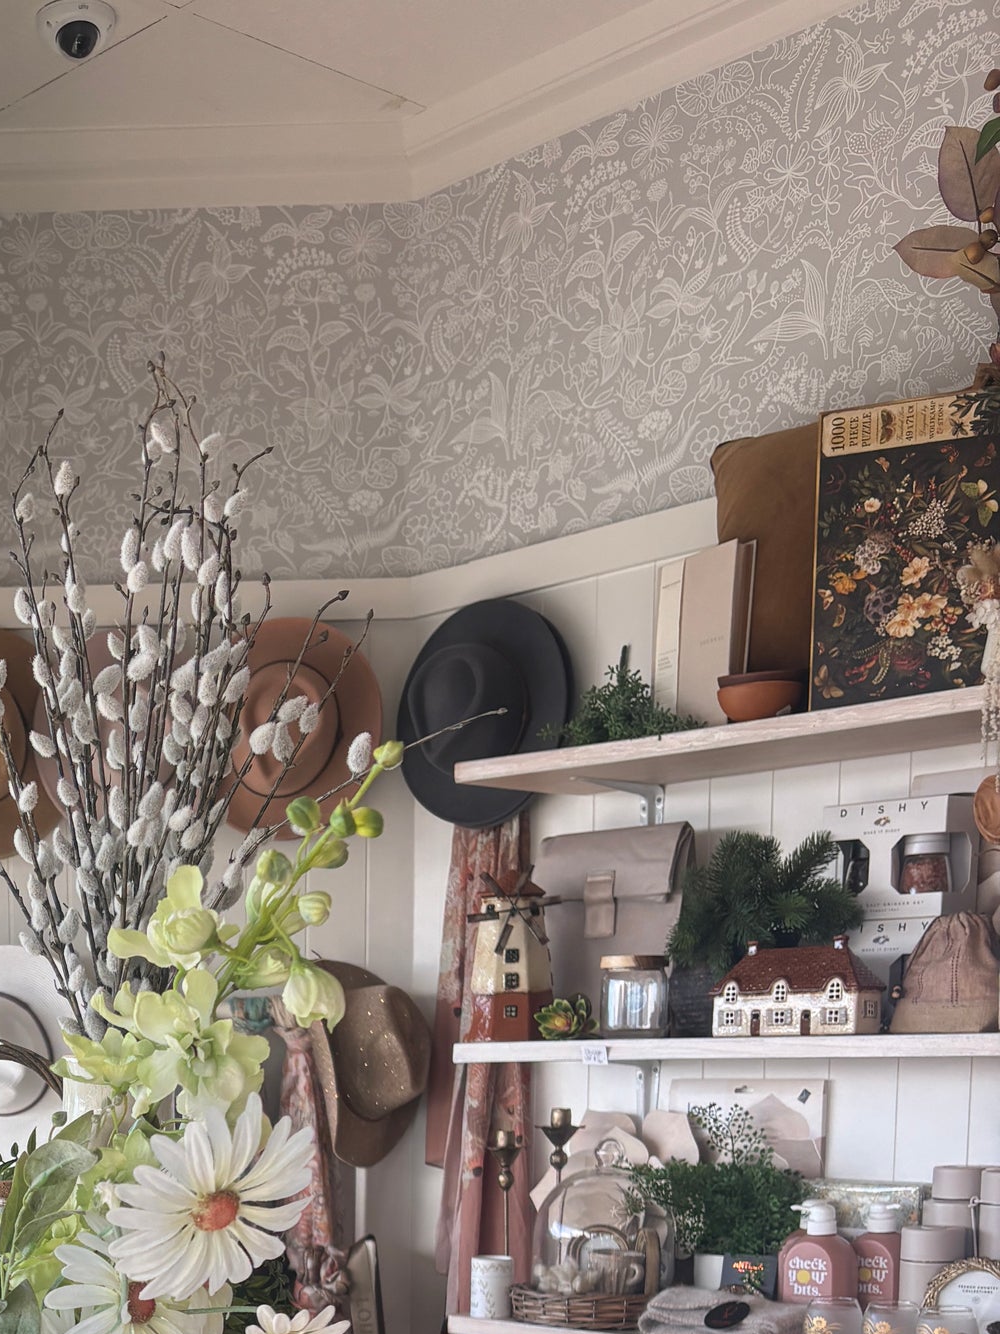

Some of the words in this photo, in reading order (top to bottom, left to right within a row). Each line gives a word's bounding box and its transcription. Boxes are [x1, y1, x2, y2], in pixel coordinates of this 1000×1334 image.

[830, 416, 846, 452] 1000
[849, 416, 859, 447] PIECE
[861, 411, 872, 447] PUZZLE
[840, 801, 928, 818] DISHY
[860, 920, 929, 934] ISHY
[788, 1255, 827, 1271] check
[858, 1256, 887, 1269] heck
[793, 1282, 822, 1297] bits.
